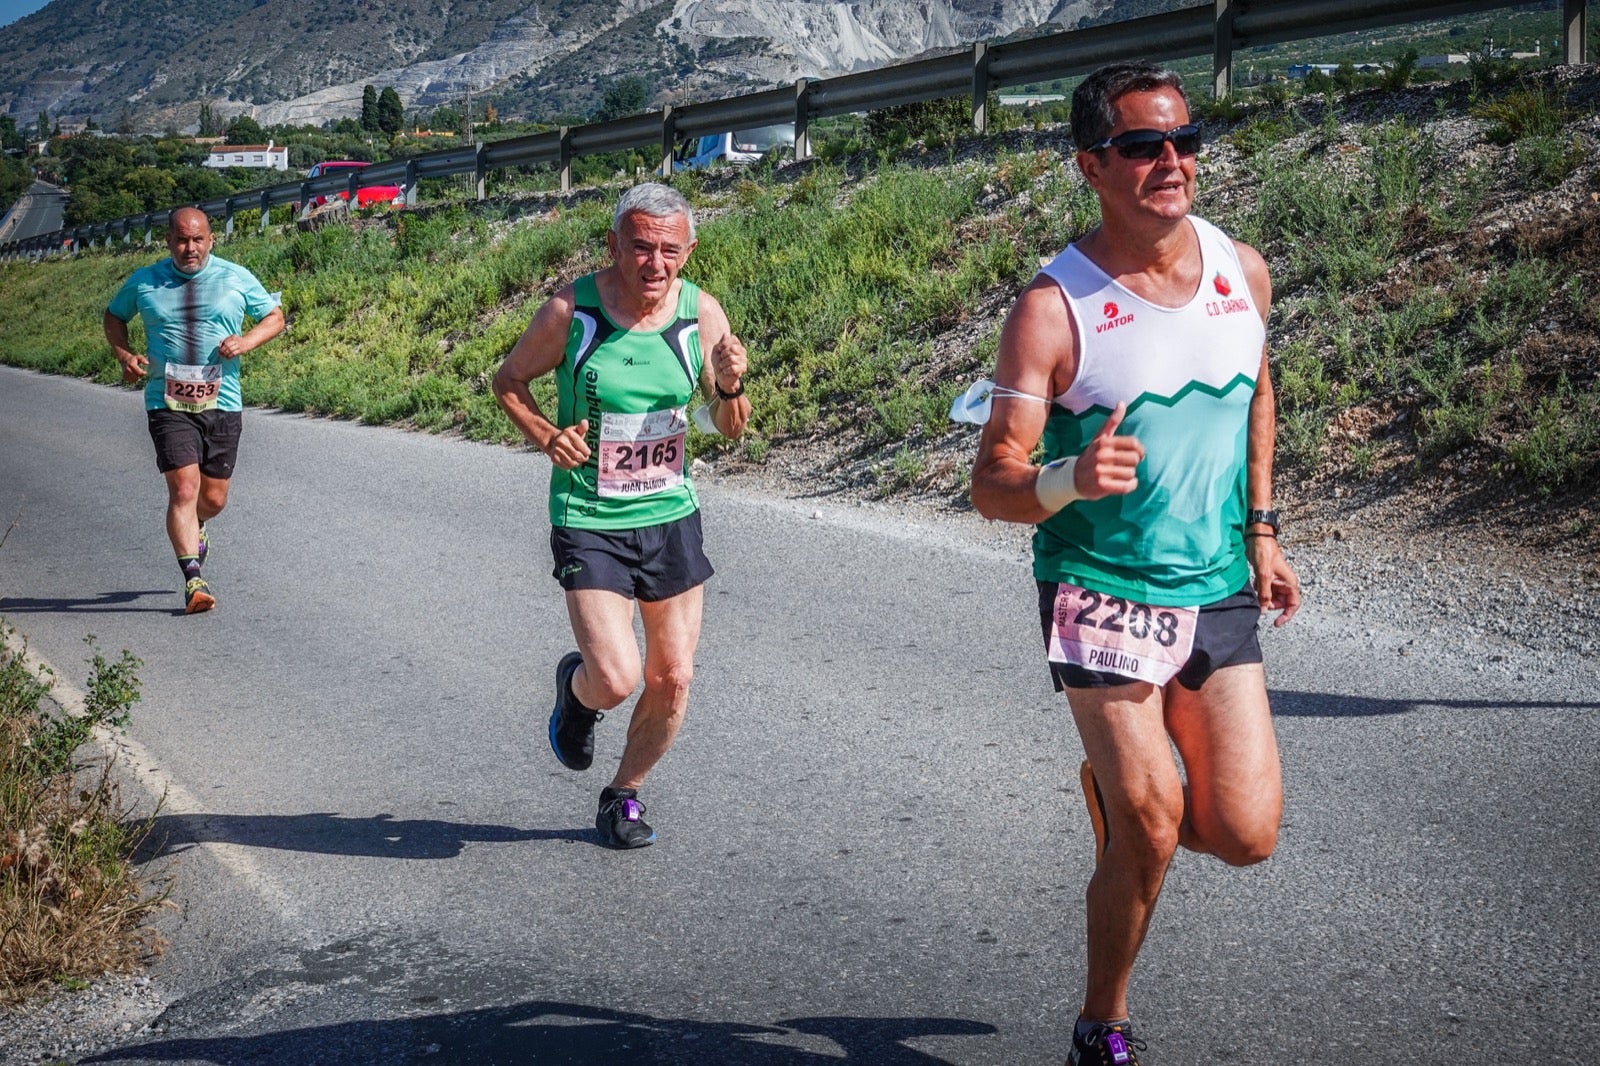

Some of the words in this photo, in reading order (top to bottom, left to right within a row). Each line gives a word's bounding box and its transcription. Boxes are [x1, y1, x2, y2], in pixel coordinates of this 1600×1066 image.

[1096, 313, 1135, 334] VIATOR
[174, 383, 215, 398] 2253
[615, 439, 677, 470] 2165
[621, 482, 641, 493] JUAN
[1058, 596, 1069, 627] MASTER
[1073, 589, 1179, 648] 2208
[1088, 648, 1139, 673] PAULINO
